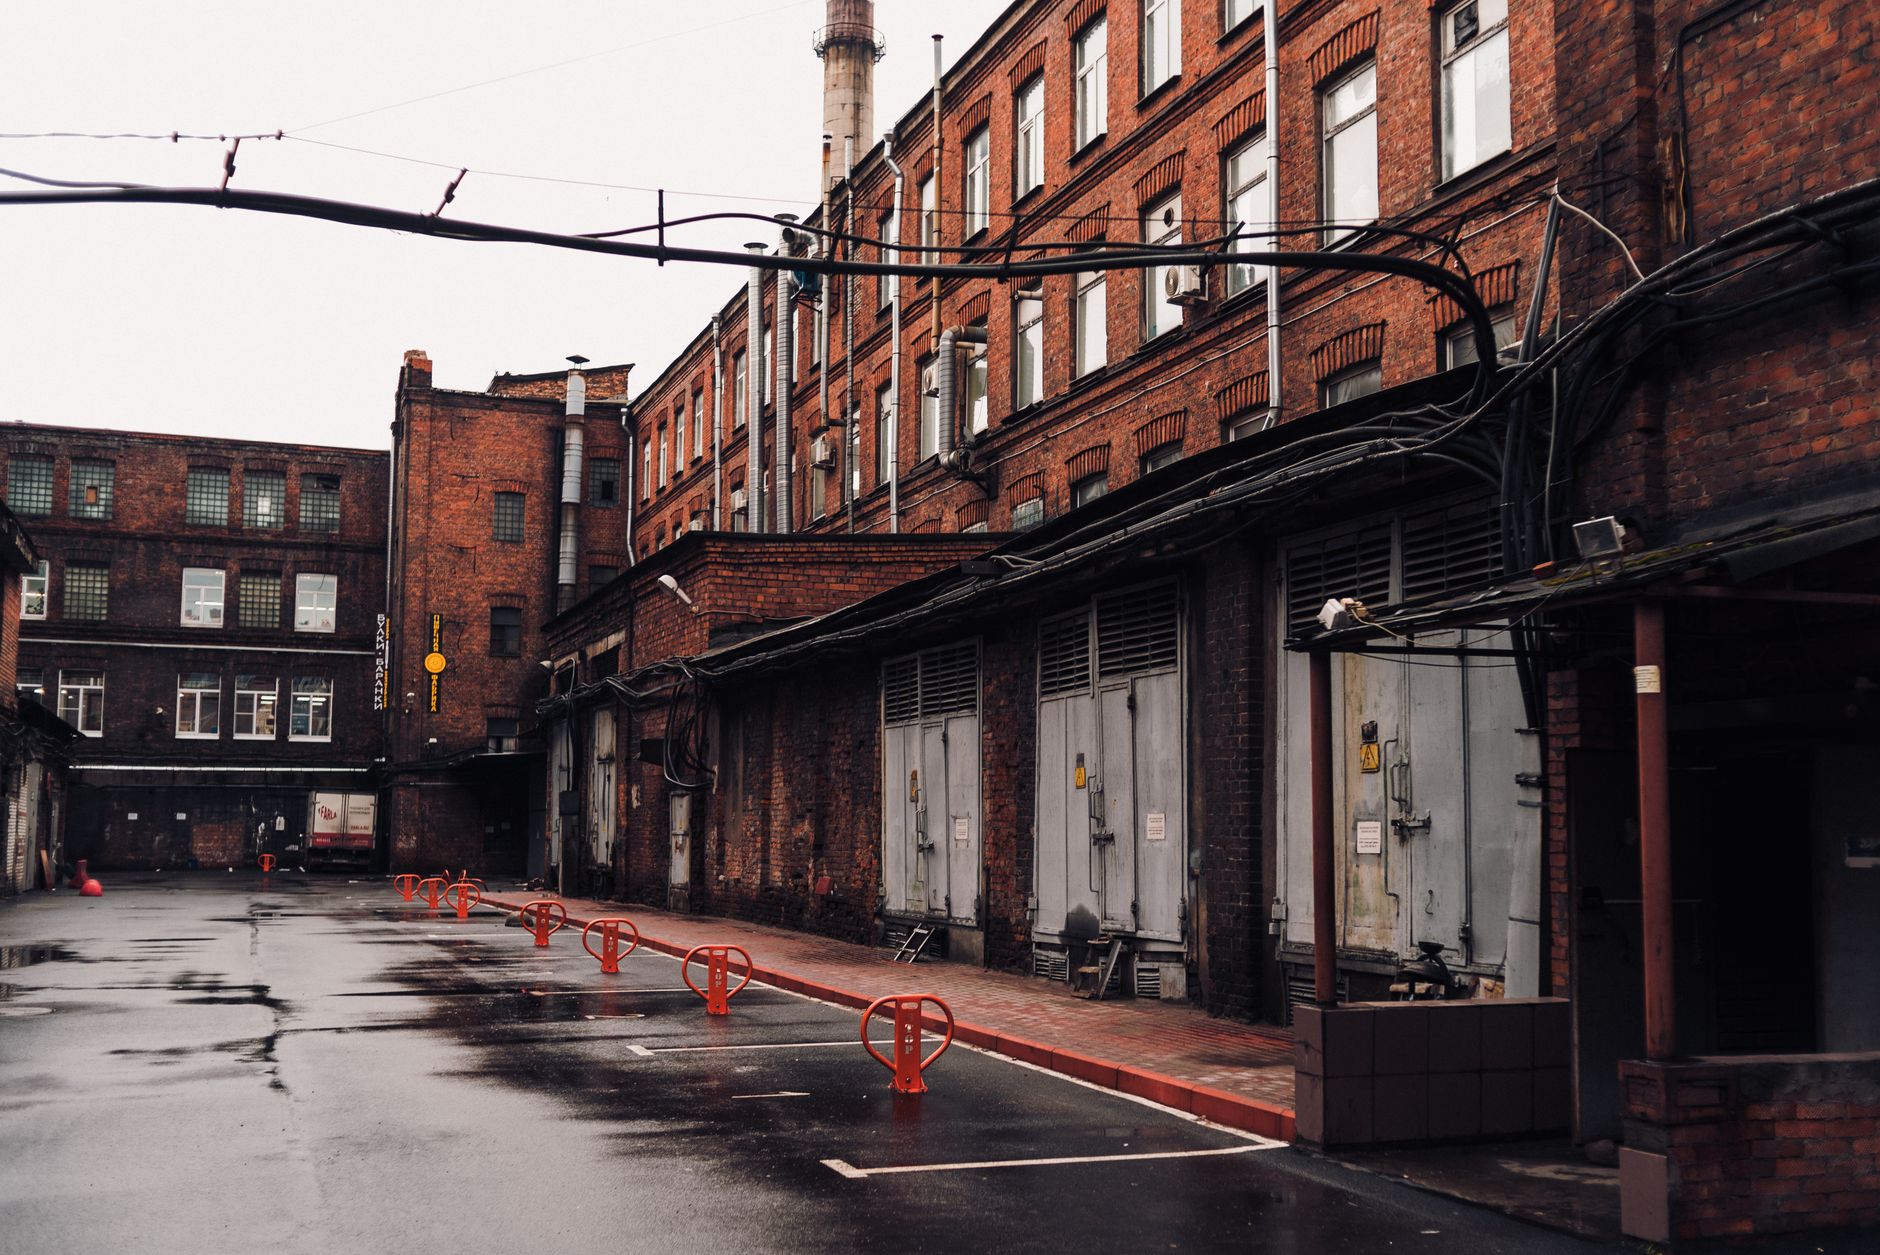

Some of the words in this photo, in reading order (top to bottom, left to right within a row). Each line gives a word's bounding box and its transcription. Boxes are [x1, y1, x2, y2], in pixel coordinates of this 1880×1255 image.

[376, 614, 385, 650] БУЛКИ
[375, 659, 384, 710] БАРАНКИ
[321, 806, 337, 820] FARLA
